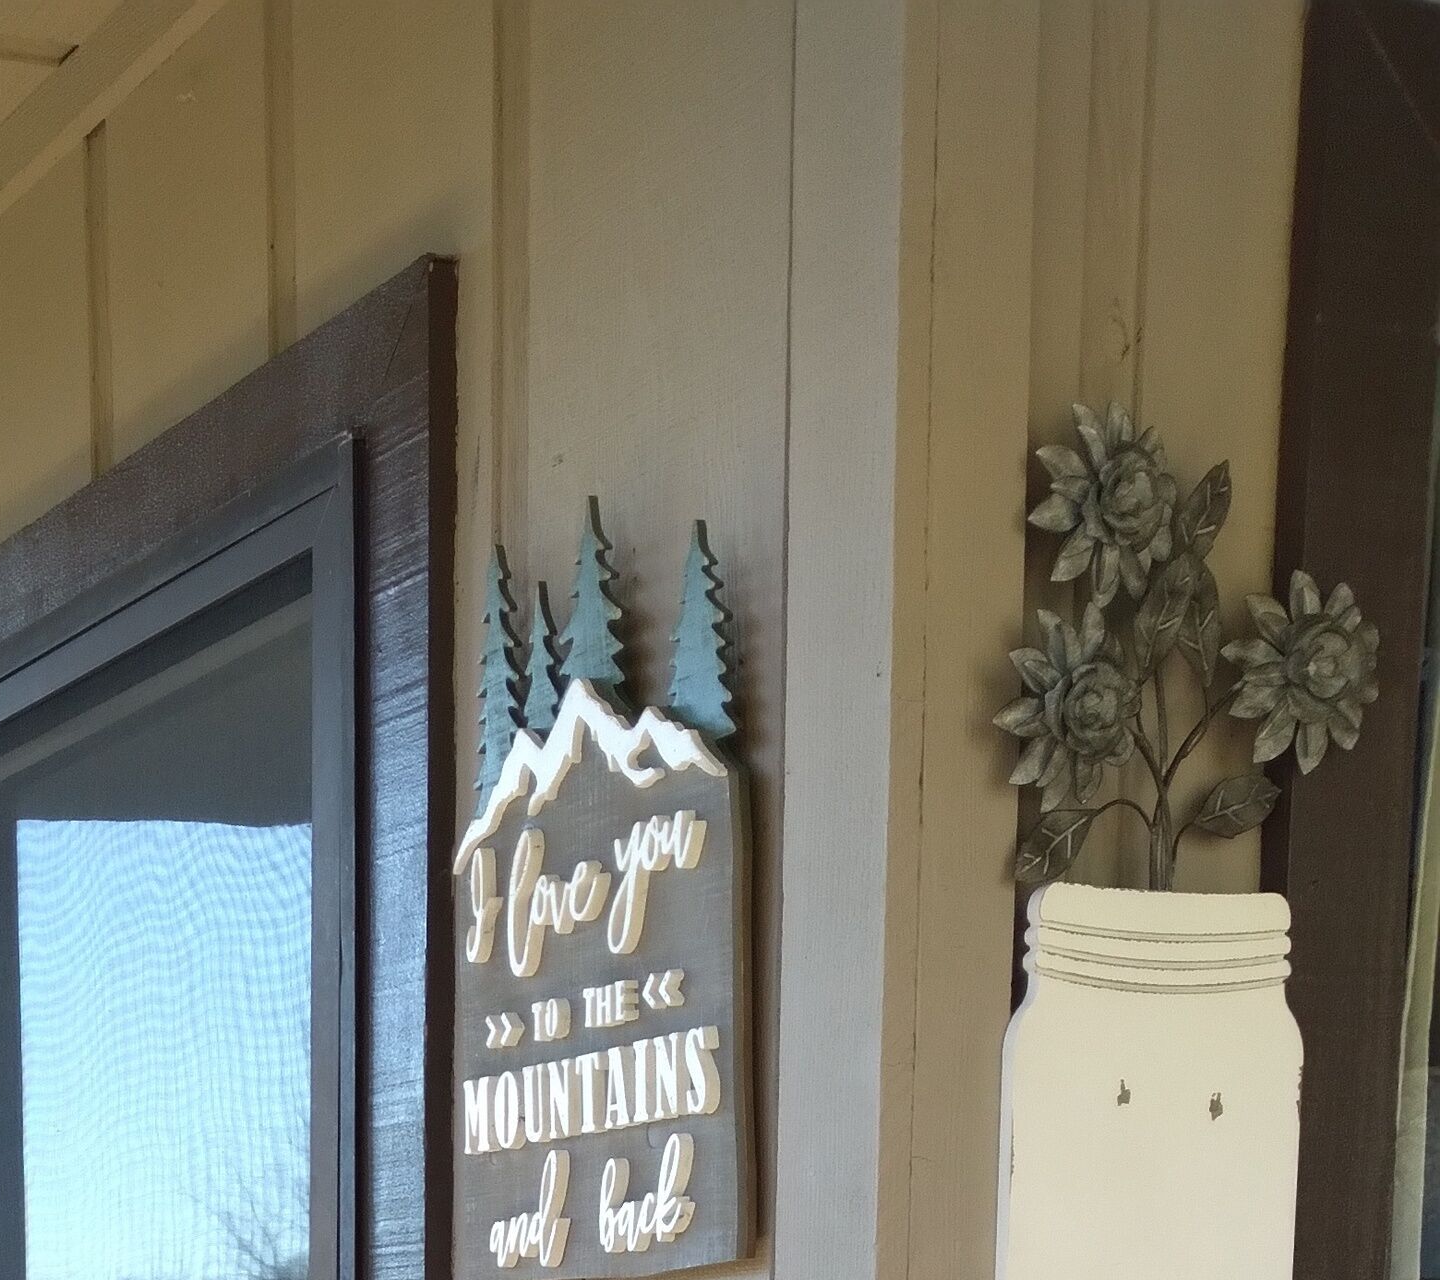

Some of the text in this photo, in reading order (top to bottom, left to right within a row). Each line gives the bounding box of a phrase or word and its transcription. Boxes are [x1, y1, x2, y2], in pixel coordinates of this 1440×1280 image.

[466, 809, 706, 977] I love you
[531, 979, 640, 1042] TO THE
[463, 1025, 720, 1155] MOUNTAINS
[490, 1133, 696, 1268] and back
